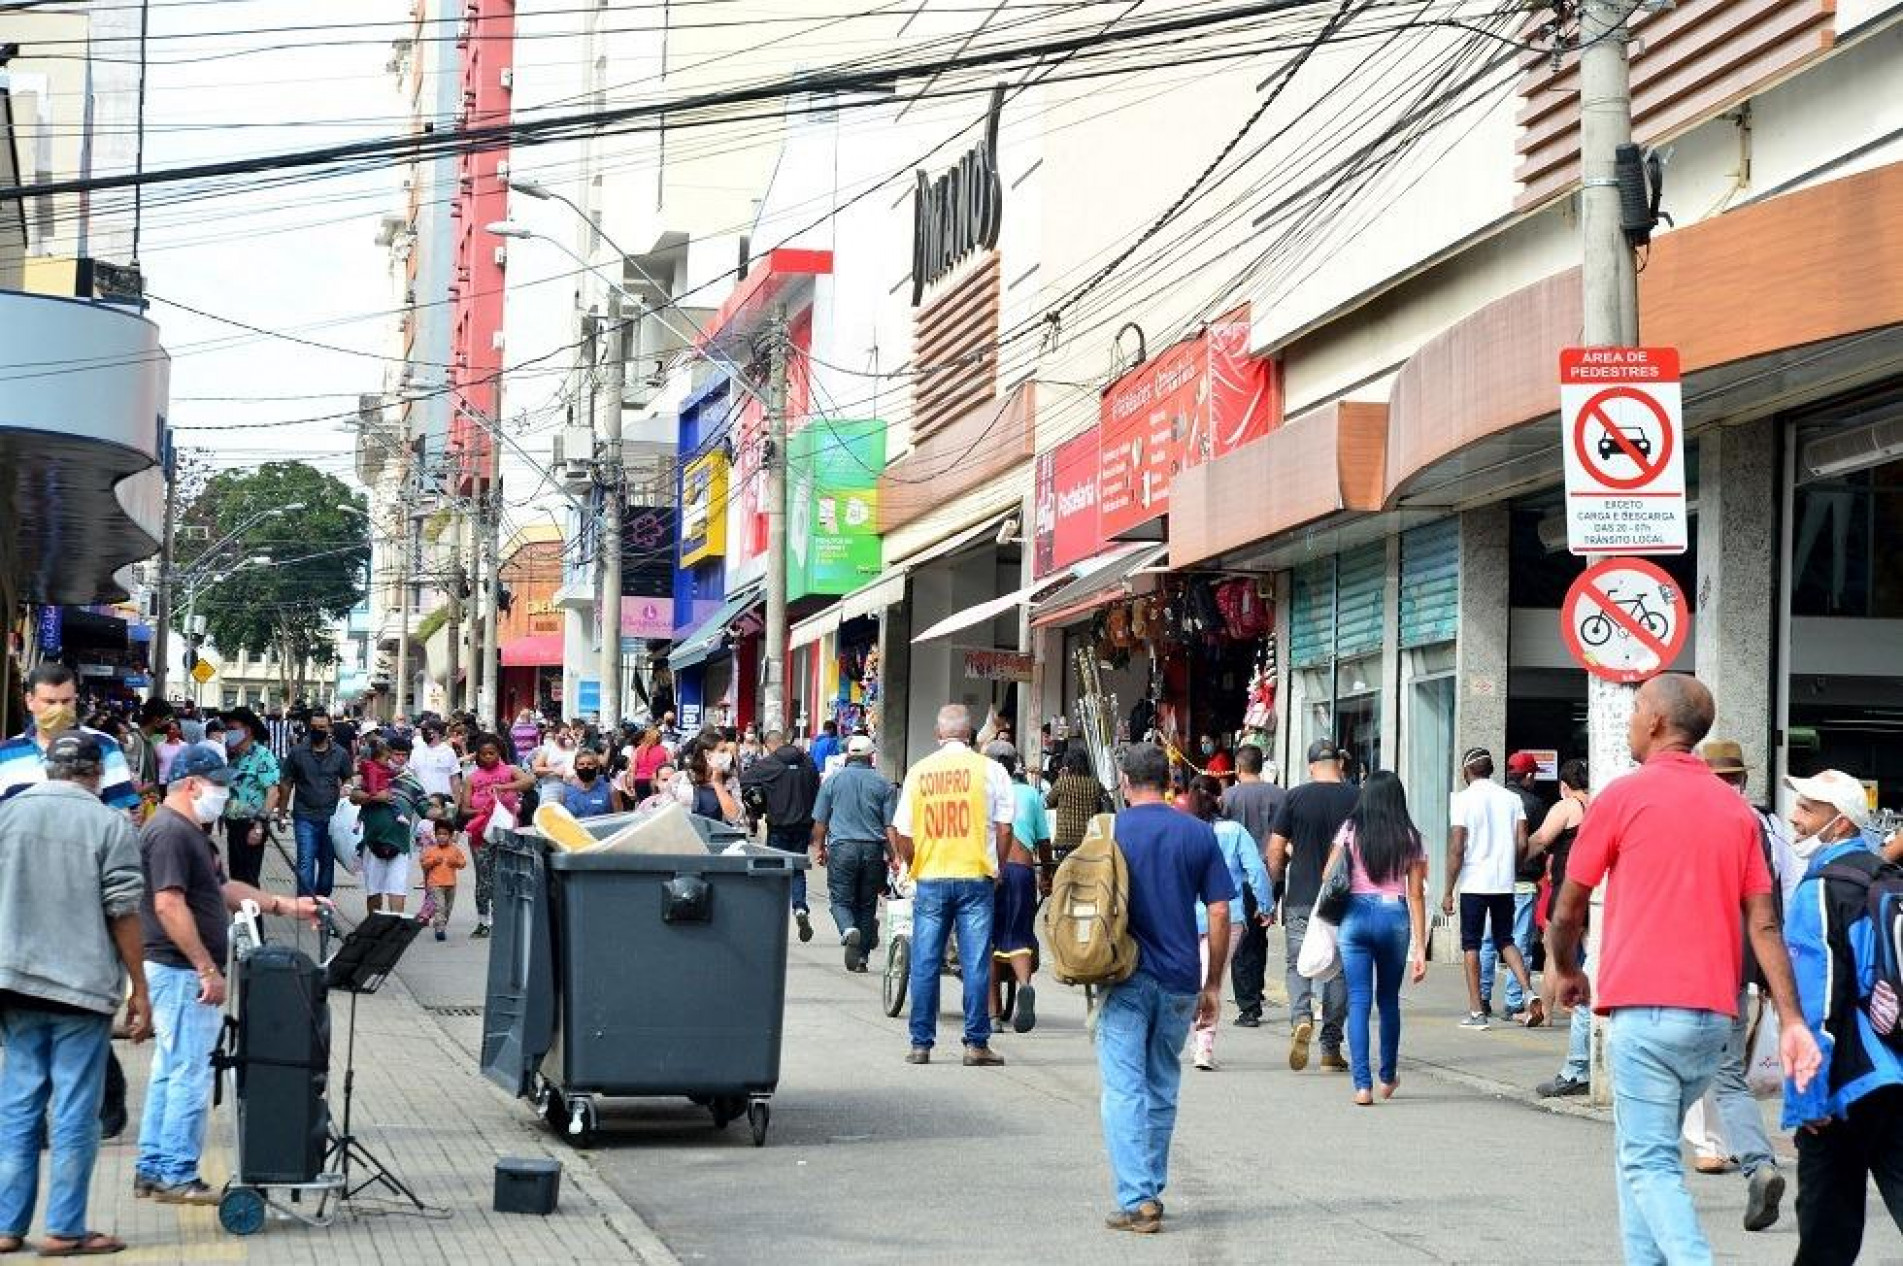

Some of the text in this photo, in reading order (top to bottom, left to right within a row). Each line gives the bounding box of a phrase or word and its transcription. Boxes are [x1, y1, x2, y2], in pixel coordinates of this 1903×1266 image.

[1626, 351, 1647, 362] DE
[1570, 366, 1660, 378] PEDESTRES
[1604, 500, 1643, 509] EXCETO
[1577, 511, 1676, 521] CARGA E DESCARGA
[1632, 535, 1665, 544] LOCAL
[919, 768, 971, 796] COMPRO
[925, 800, 970, 839] OURO
